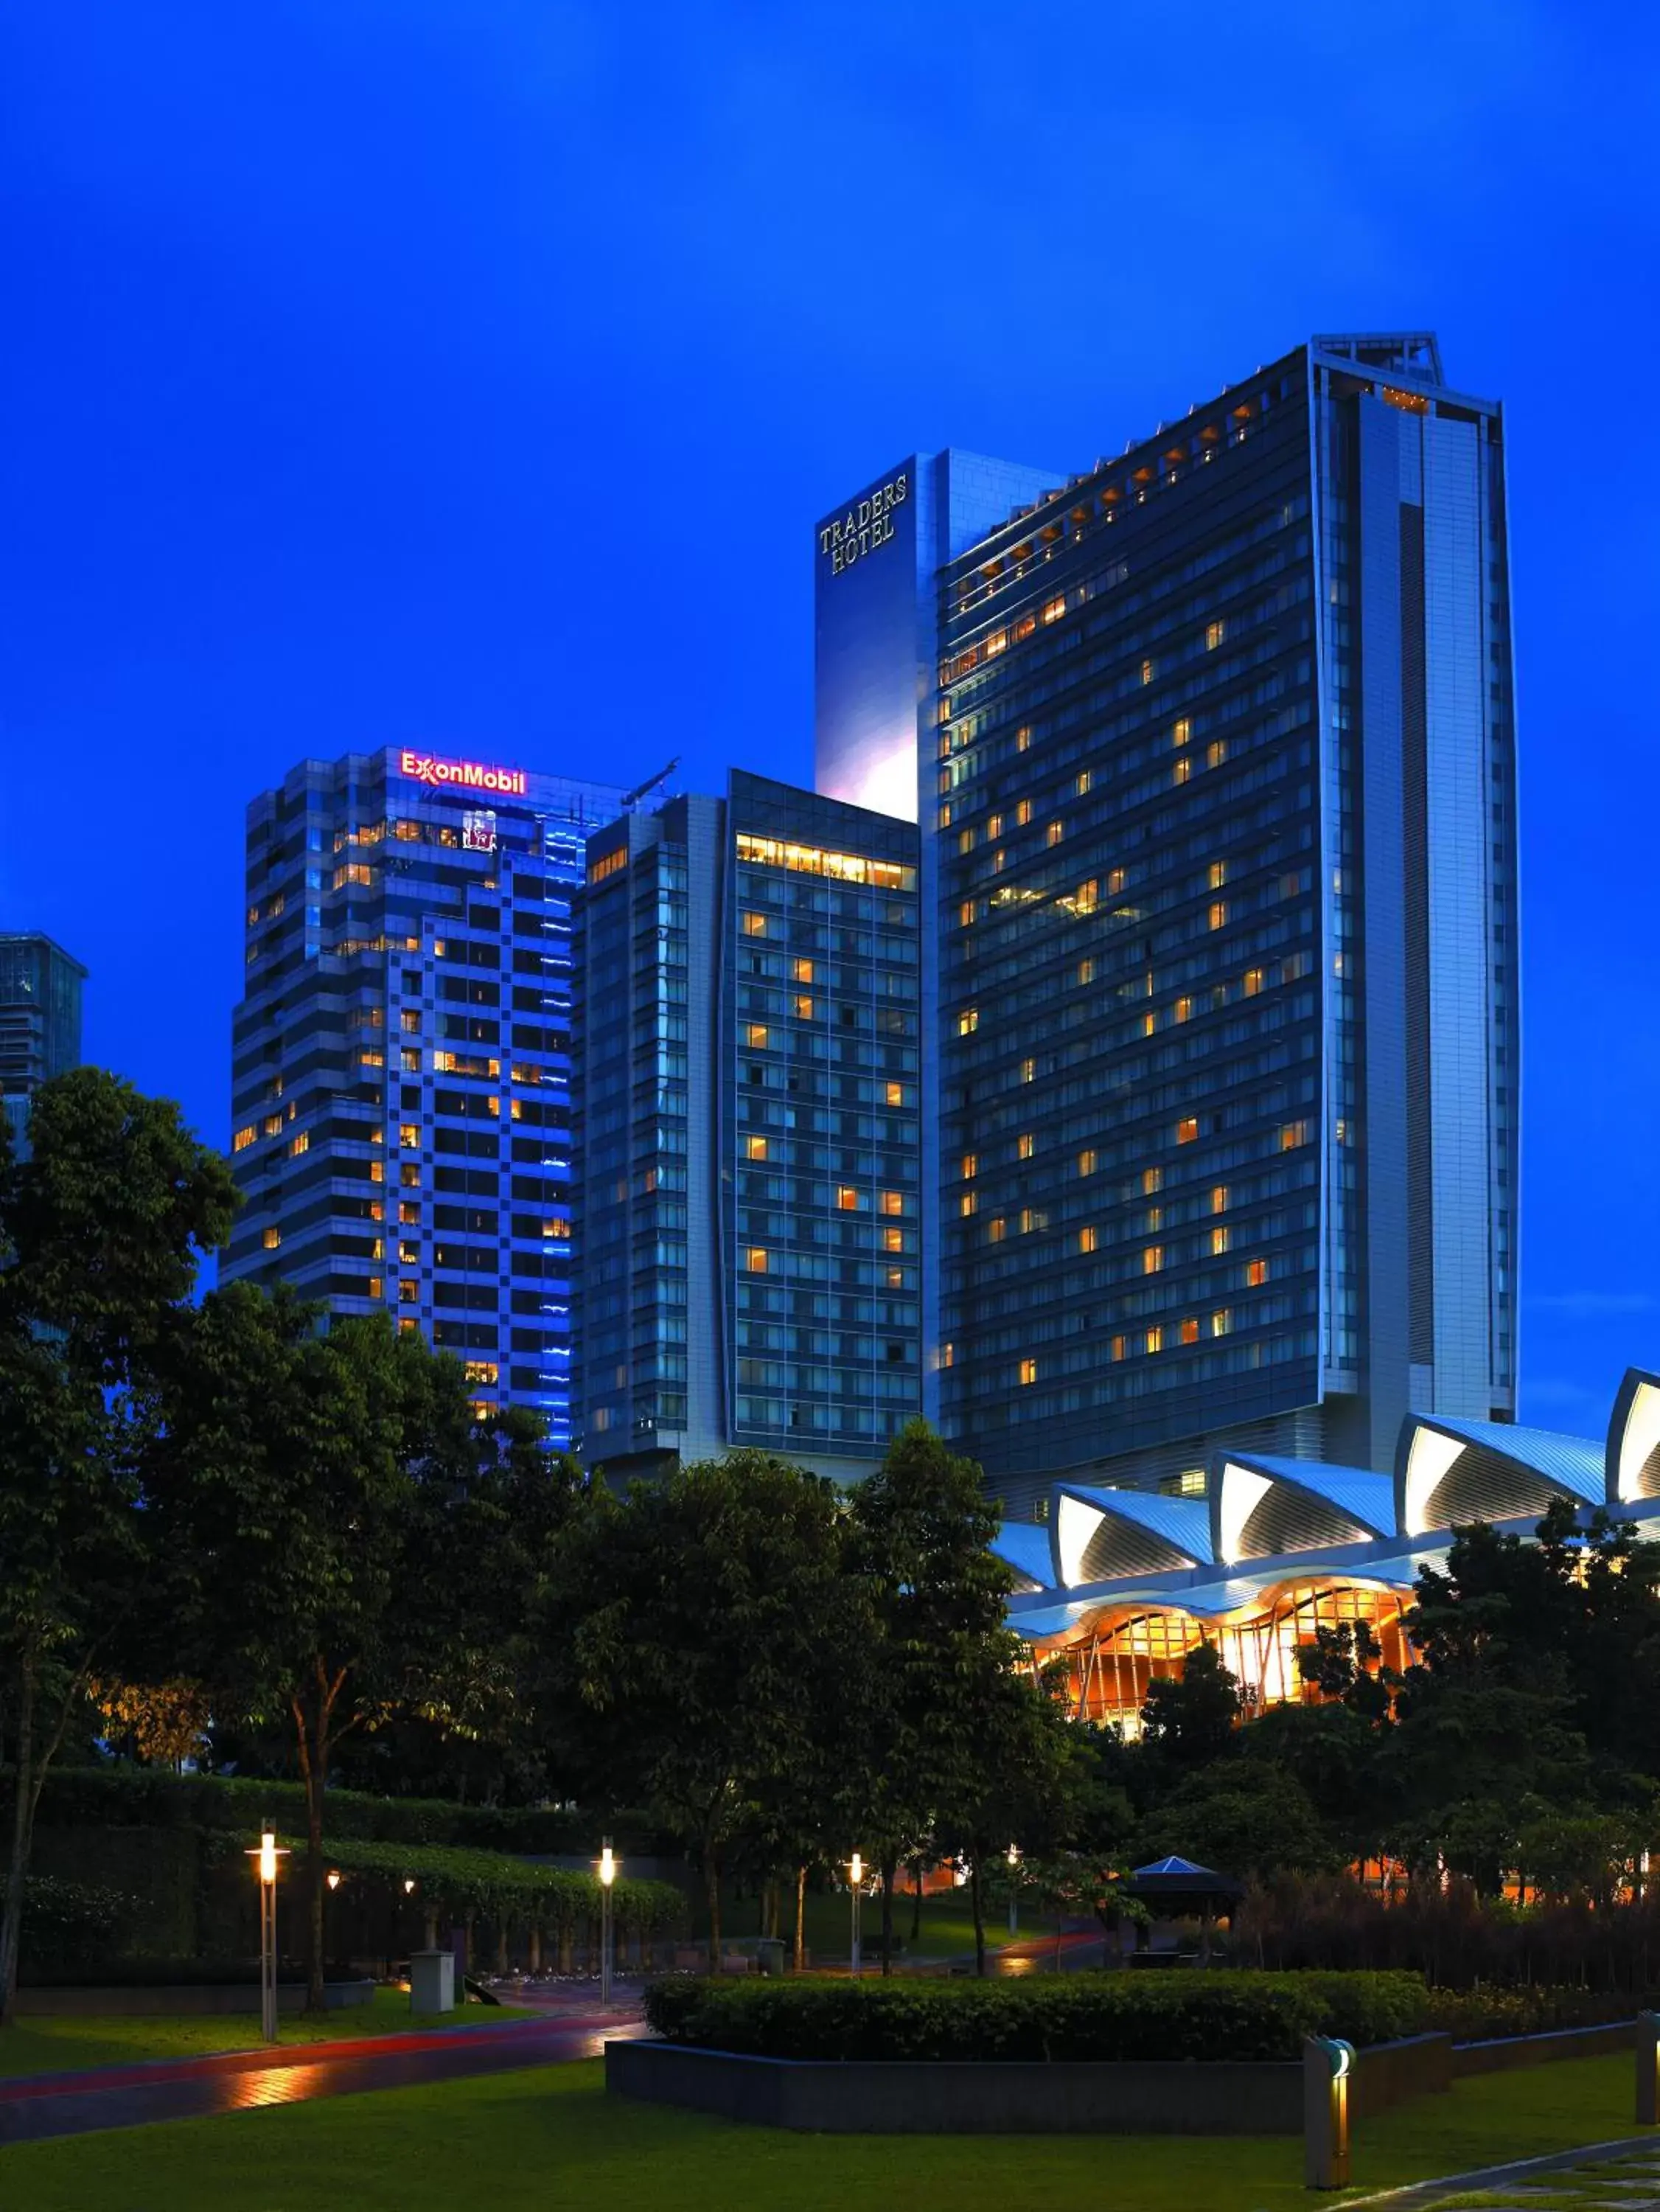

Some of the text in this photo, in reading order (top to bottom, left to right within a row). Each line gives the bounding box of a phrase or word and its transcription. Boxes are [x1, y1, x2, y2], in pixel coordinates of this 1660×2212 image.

[820, 474, 907, 553] TRADERS
[832, 515, 894, 575] HOTEL
[401, 752, 525, 794] ExxonMobil
